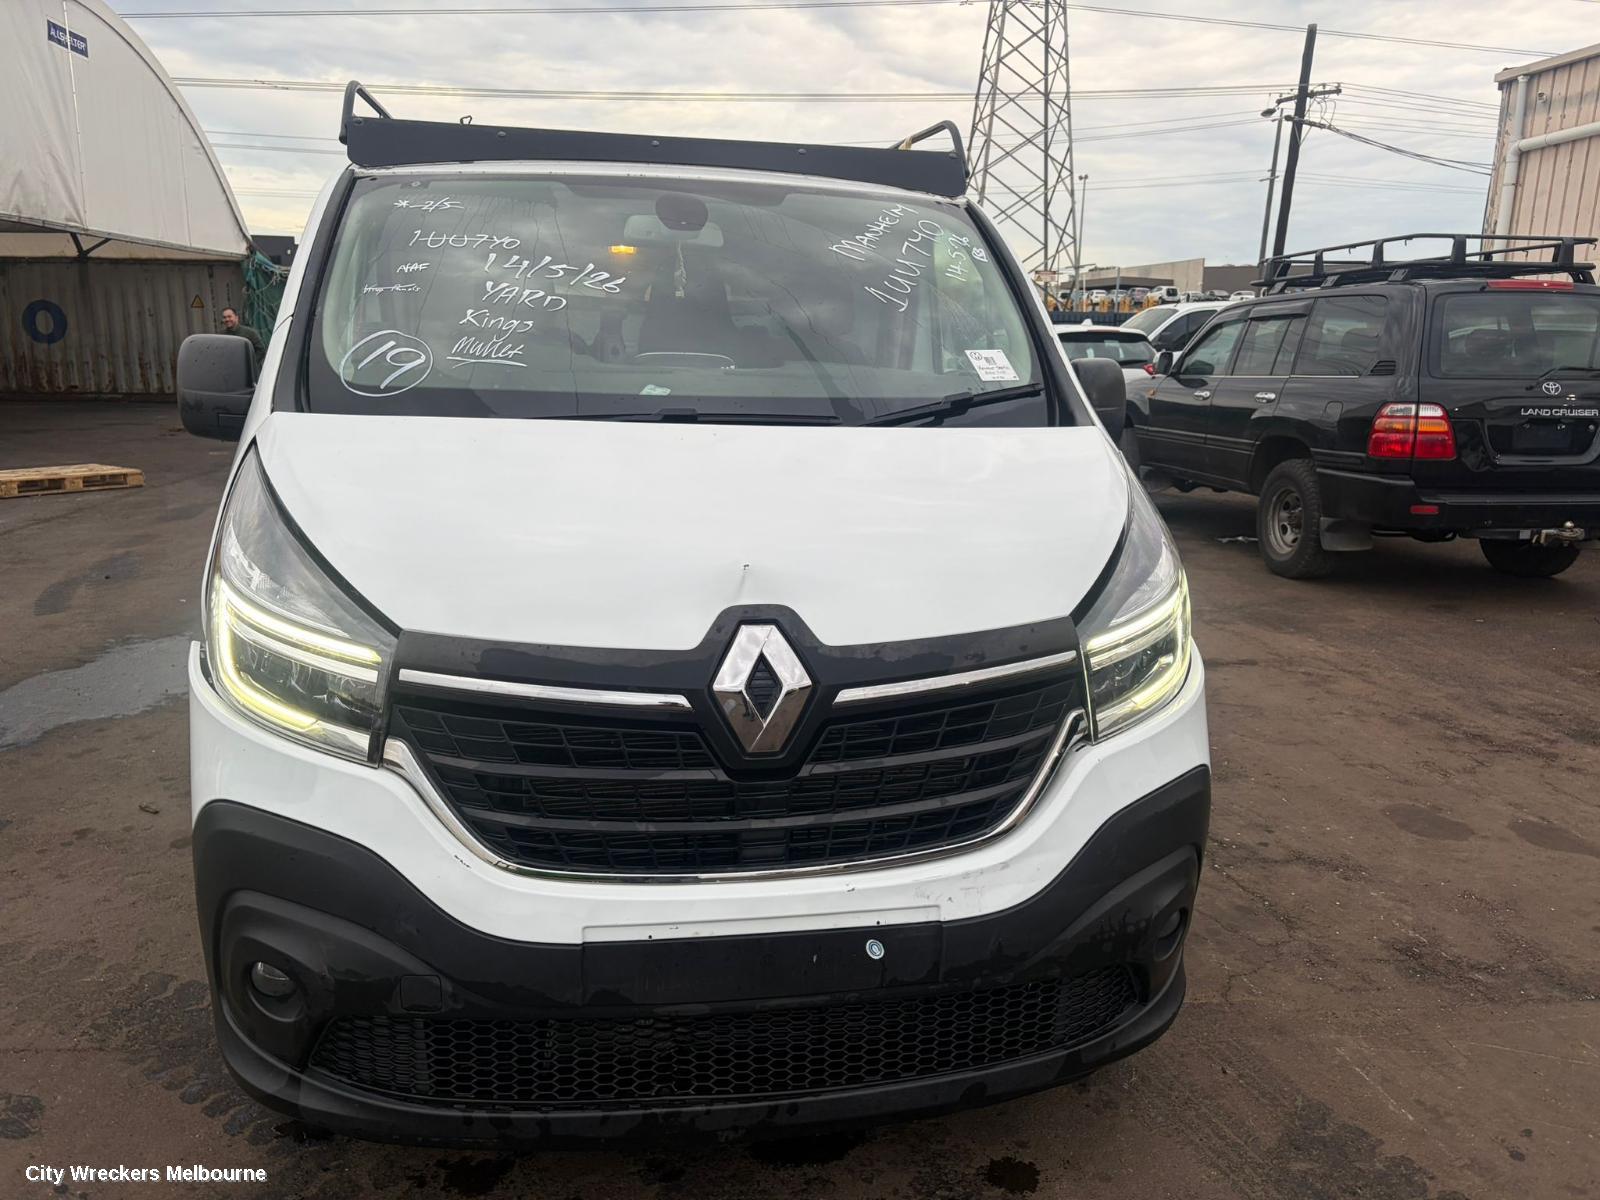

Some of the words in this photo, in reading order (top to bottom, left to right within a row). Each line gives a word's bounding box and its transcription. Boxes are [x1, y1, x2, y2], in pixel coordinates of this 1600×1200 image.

[829, 203, 919, 261] MANHEIM
[482, 281, 567, 311] YARD
[459, 309, 534, 342] Kings
[358, 340, 426, 390] 19
[1520, 408, 1551, 416] LAND
[1552, 408, 1599, 417] CRUISER
